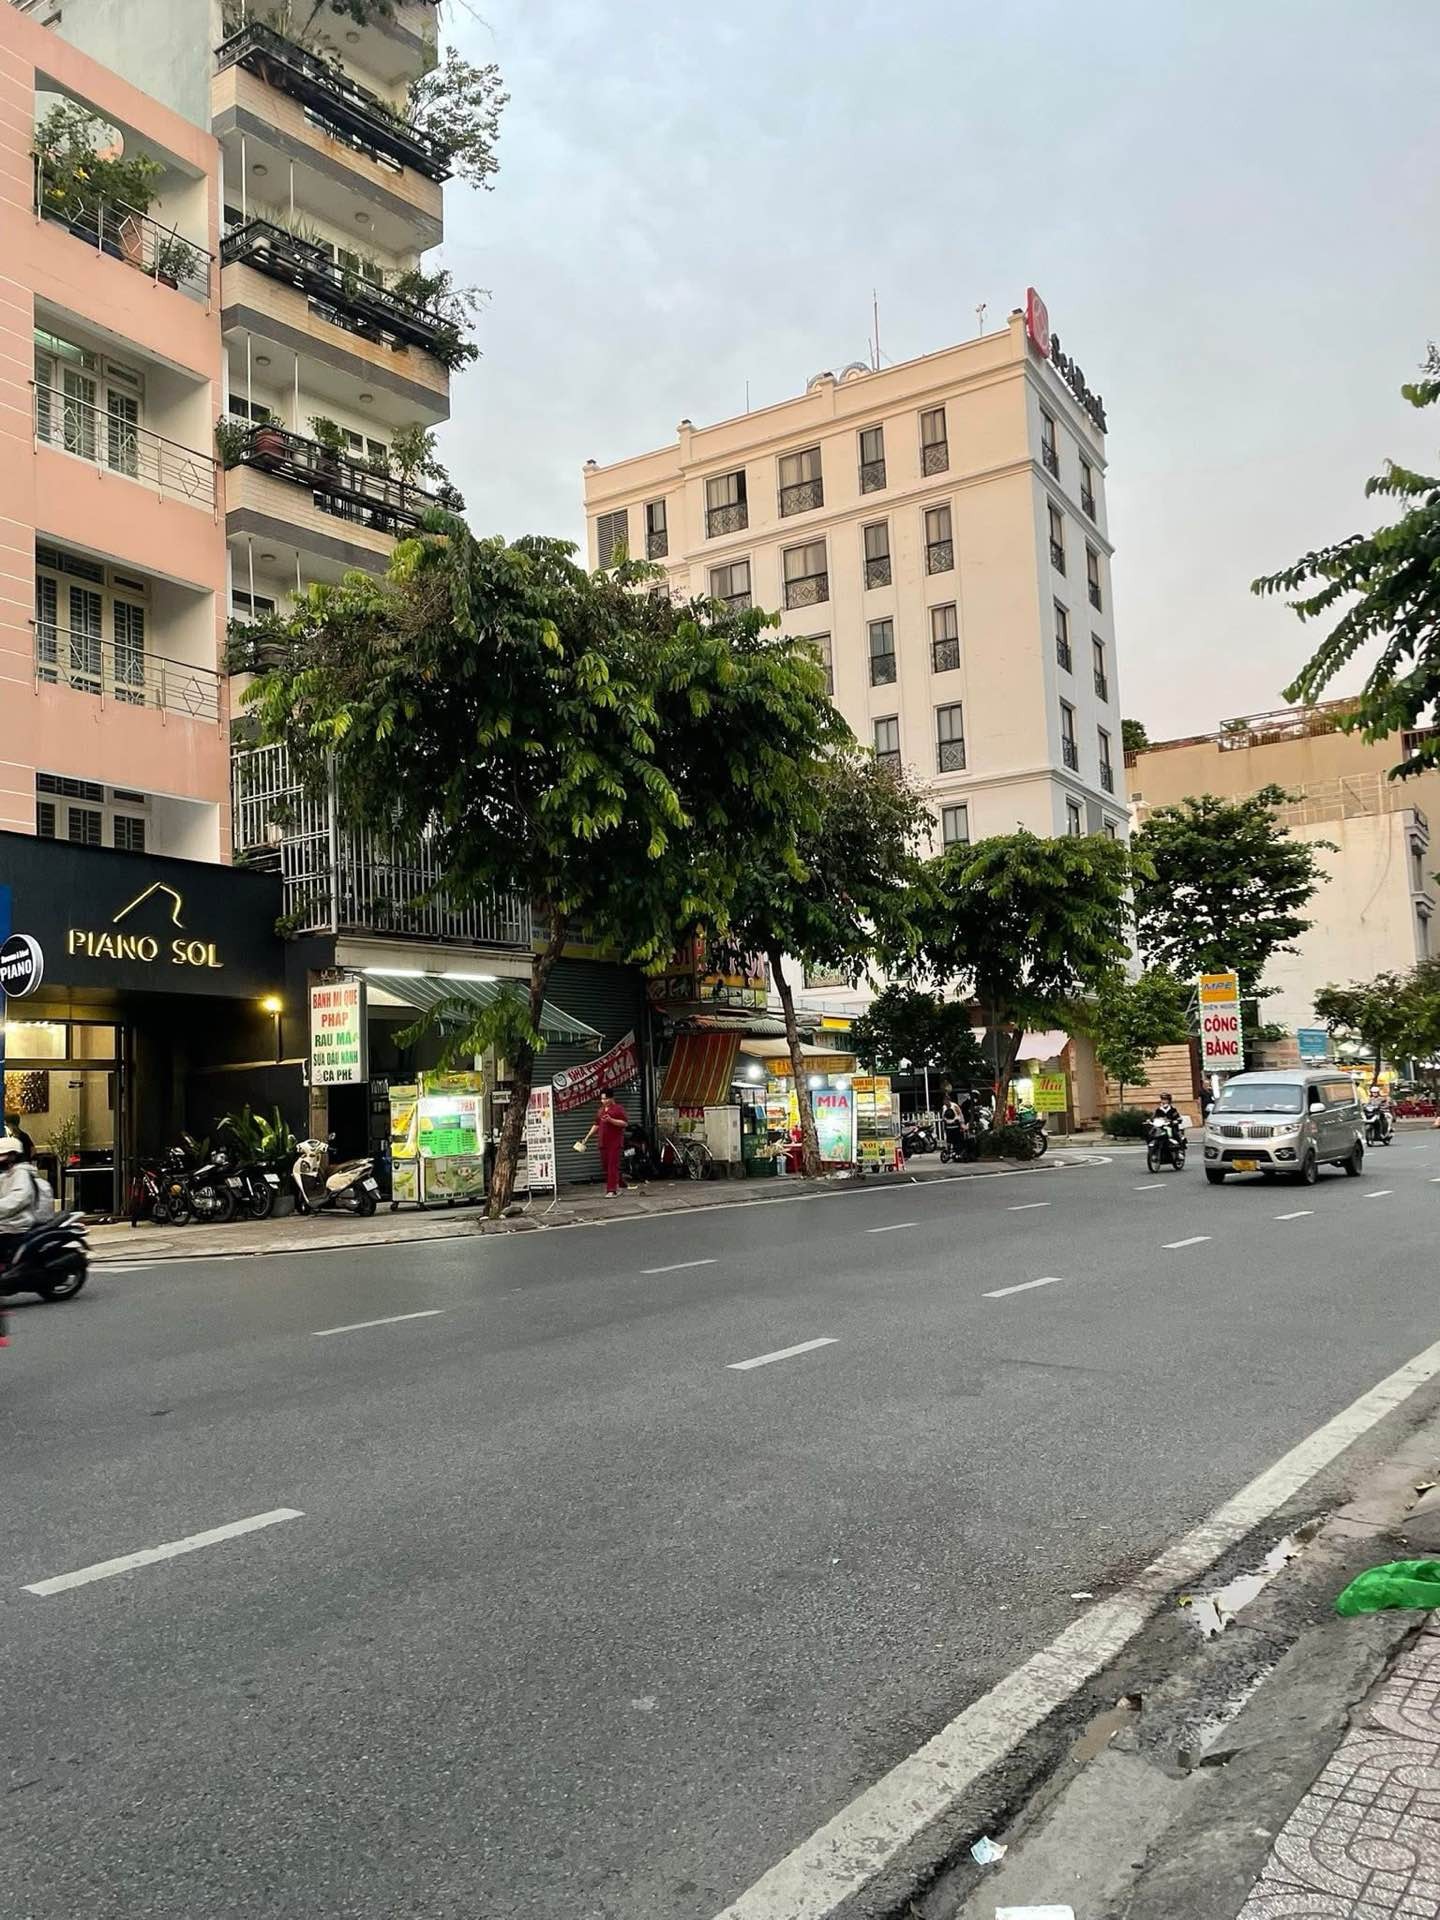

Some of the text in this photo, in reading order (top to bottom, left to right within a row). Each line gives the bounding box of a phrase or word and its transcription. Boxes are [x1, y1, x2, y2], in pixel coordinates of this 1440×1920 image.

[69, 929, 224, 968] PIANO SOL
[0, 959, 32, 982] PIANO
[1204, 1014, 1238, 1032] CÔNG
[315, 1033, 333, 1047] RAU
